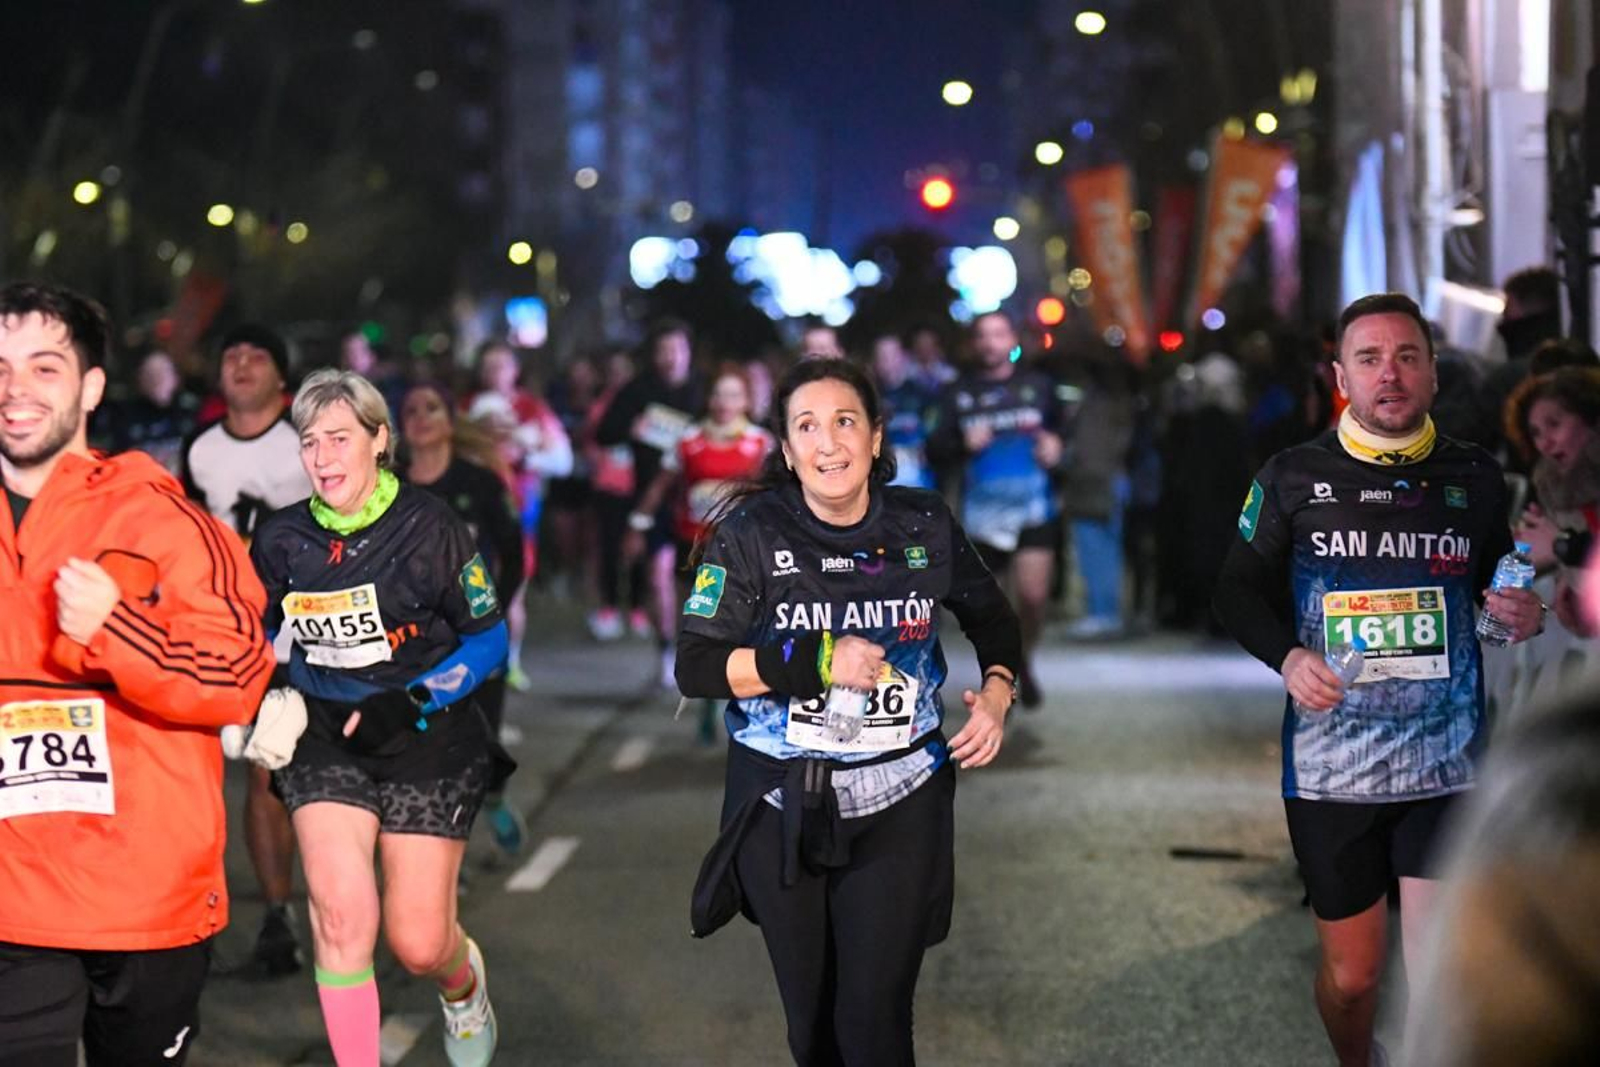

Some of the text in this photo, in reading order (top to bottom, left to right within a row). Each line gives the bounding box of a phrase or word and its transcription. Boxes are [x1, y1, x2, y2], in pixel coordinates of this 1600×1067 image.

[1311, 527, 1470, 562] SAN ANTÓN
[775, 591, 934, 630] SAN ANTÓN
[1348, 596, 1371, 612] 42
[291, 611, 378, 639] 10155
[1335, 613, 1437, 649] 1618
[0, 732, 97, 772] 784
